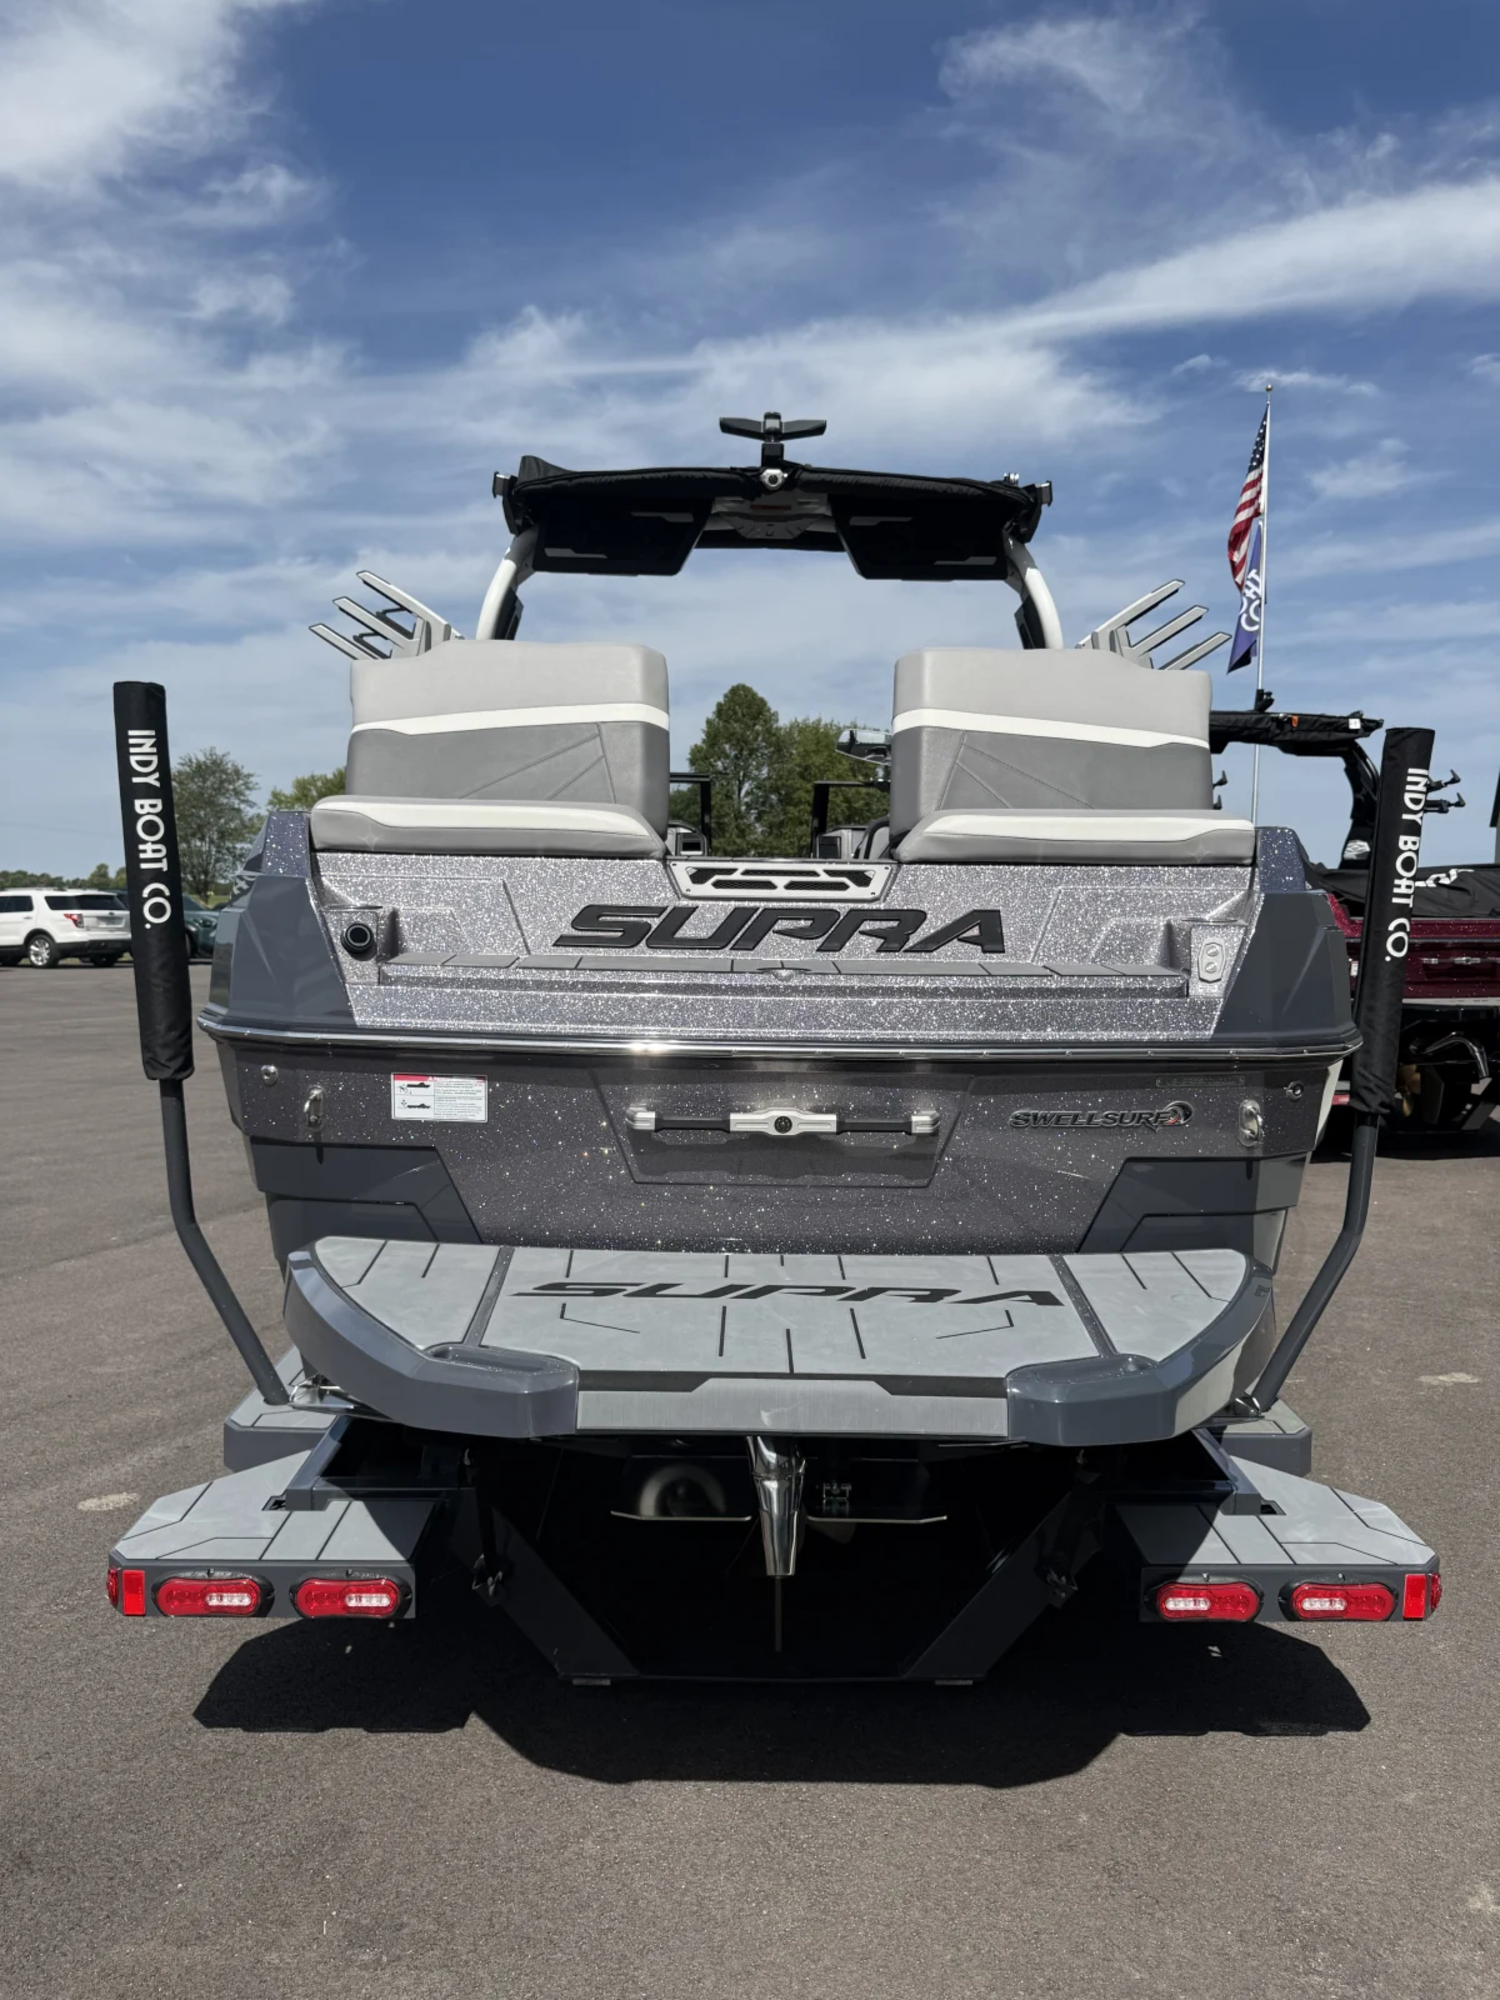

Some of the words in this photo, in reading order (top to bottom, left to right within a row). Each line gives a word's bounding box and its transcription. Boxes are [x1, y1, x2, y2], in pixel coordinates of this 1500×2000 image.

[127, 730, 161, 788] INDY
[1401, 767, 1430, 826] INDY
[134, 798, 168, 872] BOAT
[1391, 835, 1420, 908] BOAT
[142, 882, 172, 929] CO.
[552, 904, 1005, 954] SUPRA
[1385, 917, 1411, 962] CO.
[1009, 1109, 1173, 1129] SWELLSURF
[508, 1281, 1066, 1307] SUPRA
